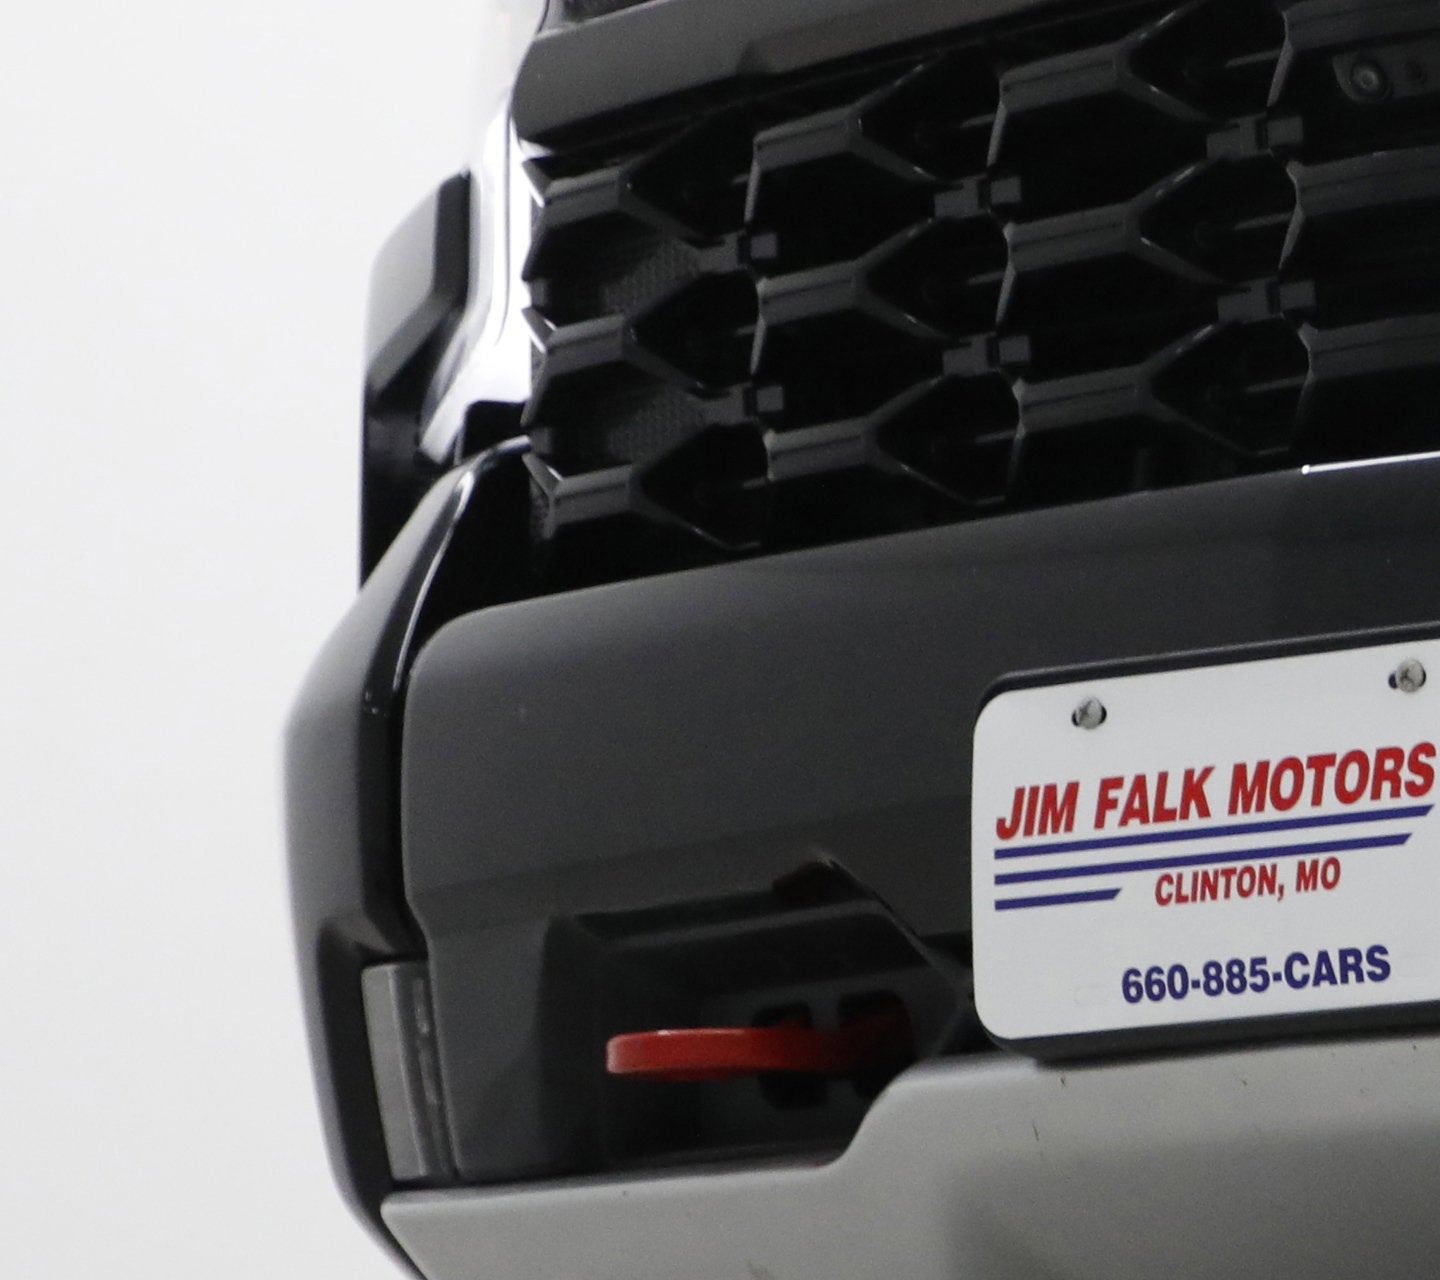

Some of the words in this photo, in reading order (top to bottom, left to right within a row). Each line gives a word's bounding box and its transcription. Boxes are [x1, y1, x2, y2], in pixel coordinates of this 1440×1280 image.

[996, 781, 1080, 841] JIM
[1094, 766, 1215, 830] FALK
[1227, 742, 1437, 816] MOTORS
[1155, 864, 1285, 907] CLINTON,
[1296, 856, 1342, 892] MO
[1121, 943, 1391, 1004] 660-885-CARS
